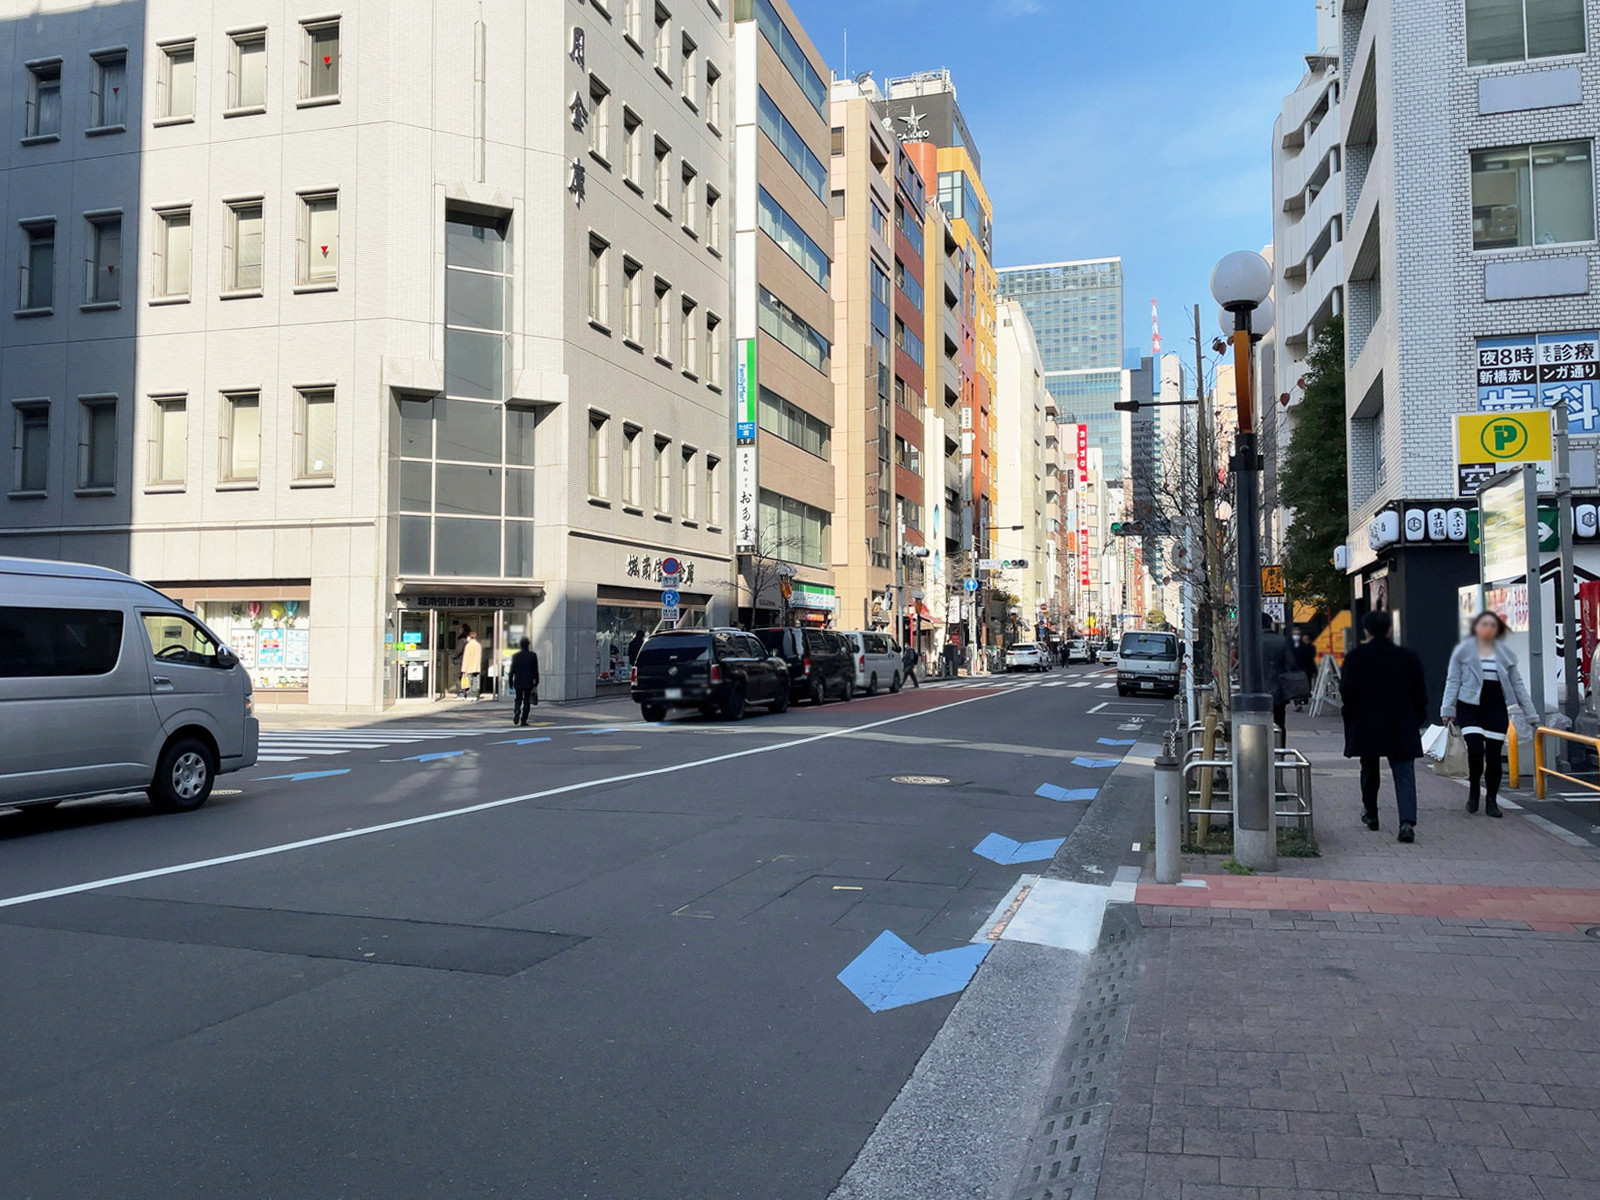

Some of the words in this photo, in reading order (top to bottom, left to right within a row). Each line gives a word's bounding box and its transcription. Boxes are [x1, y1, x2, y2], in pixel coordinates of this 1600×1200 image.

[738, 363, 746, 403] FamilyMart
[1480, 364, 1596, 384] 新橋赤レンガ通り
[1453, 511, 1464, 536] 天ぷら
[625, 554, 695, 588] 城南信金庫
